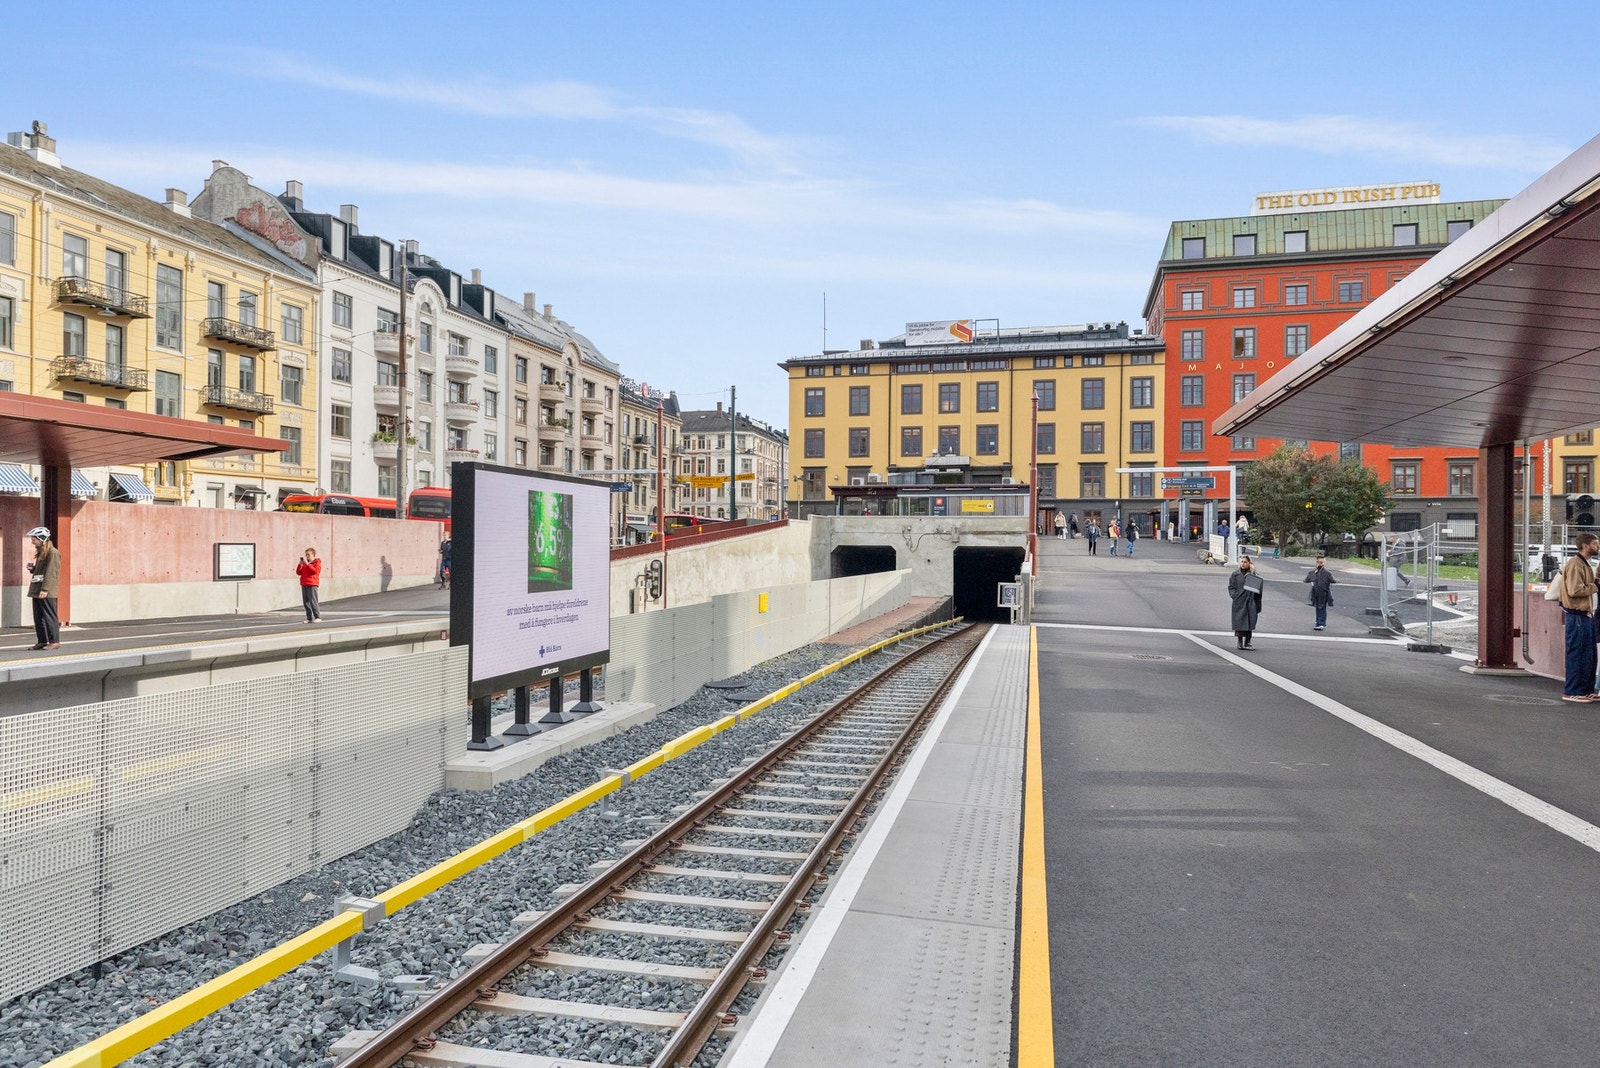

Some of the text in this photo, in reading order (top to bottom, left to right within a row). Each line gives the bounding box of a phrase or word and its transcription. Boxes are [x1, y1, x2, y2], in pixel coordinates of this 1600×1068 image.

[1256, 183, 1440, 209] THE OLD IRISH PUB
[536, 522, 566, 561] 6,5%
[514, 604, 532, 615] norske
[519, 618, 531, 630] med
[535, 616, 553, 628] fungere
